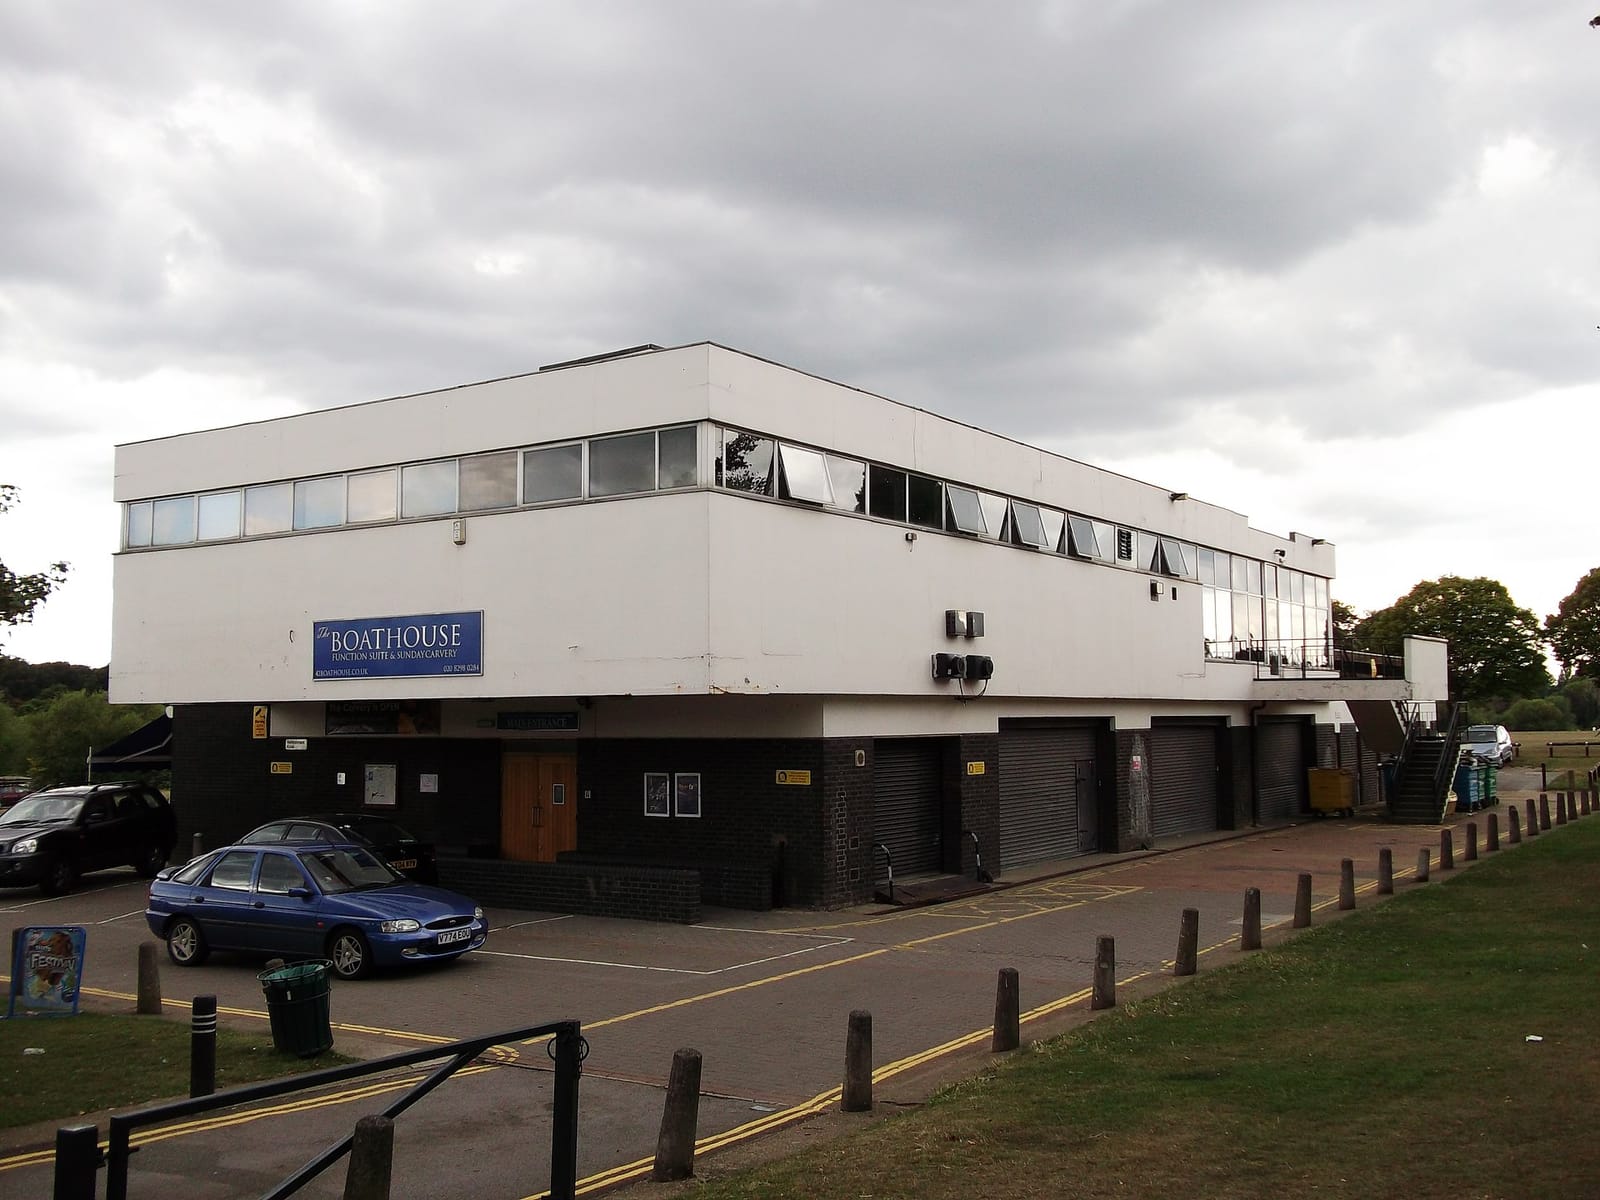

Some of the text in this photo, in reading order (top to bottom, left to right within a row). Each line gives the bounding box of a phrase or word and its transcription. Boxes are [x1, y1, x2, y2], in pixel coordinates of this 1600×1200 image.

[316, 624, 461, 652] The BOATHOUSE
[332, 652, 368, 661] FUNCTION
[369, 651, 388, 660] SUITE
[389, 650, 396, 660] &
[527, 718, 568, 729] ENTRANCE
[439, 931, 457, 943] V774
